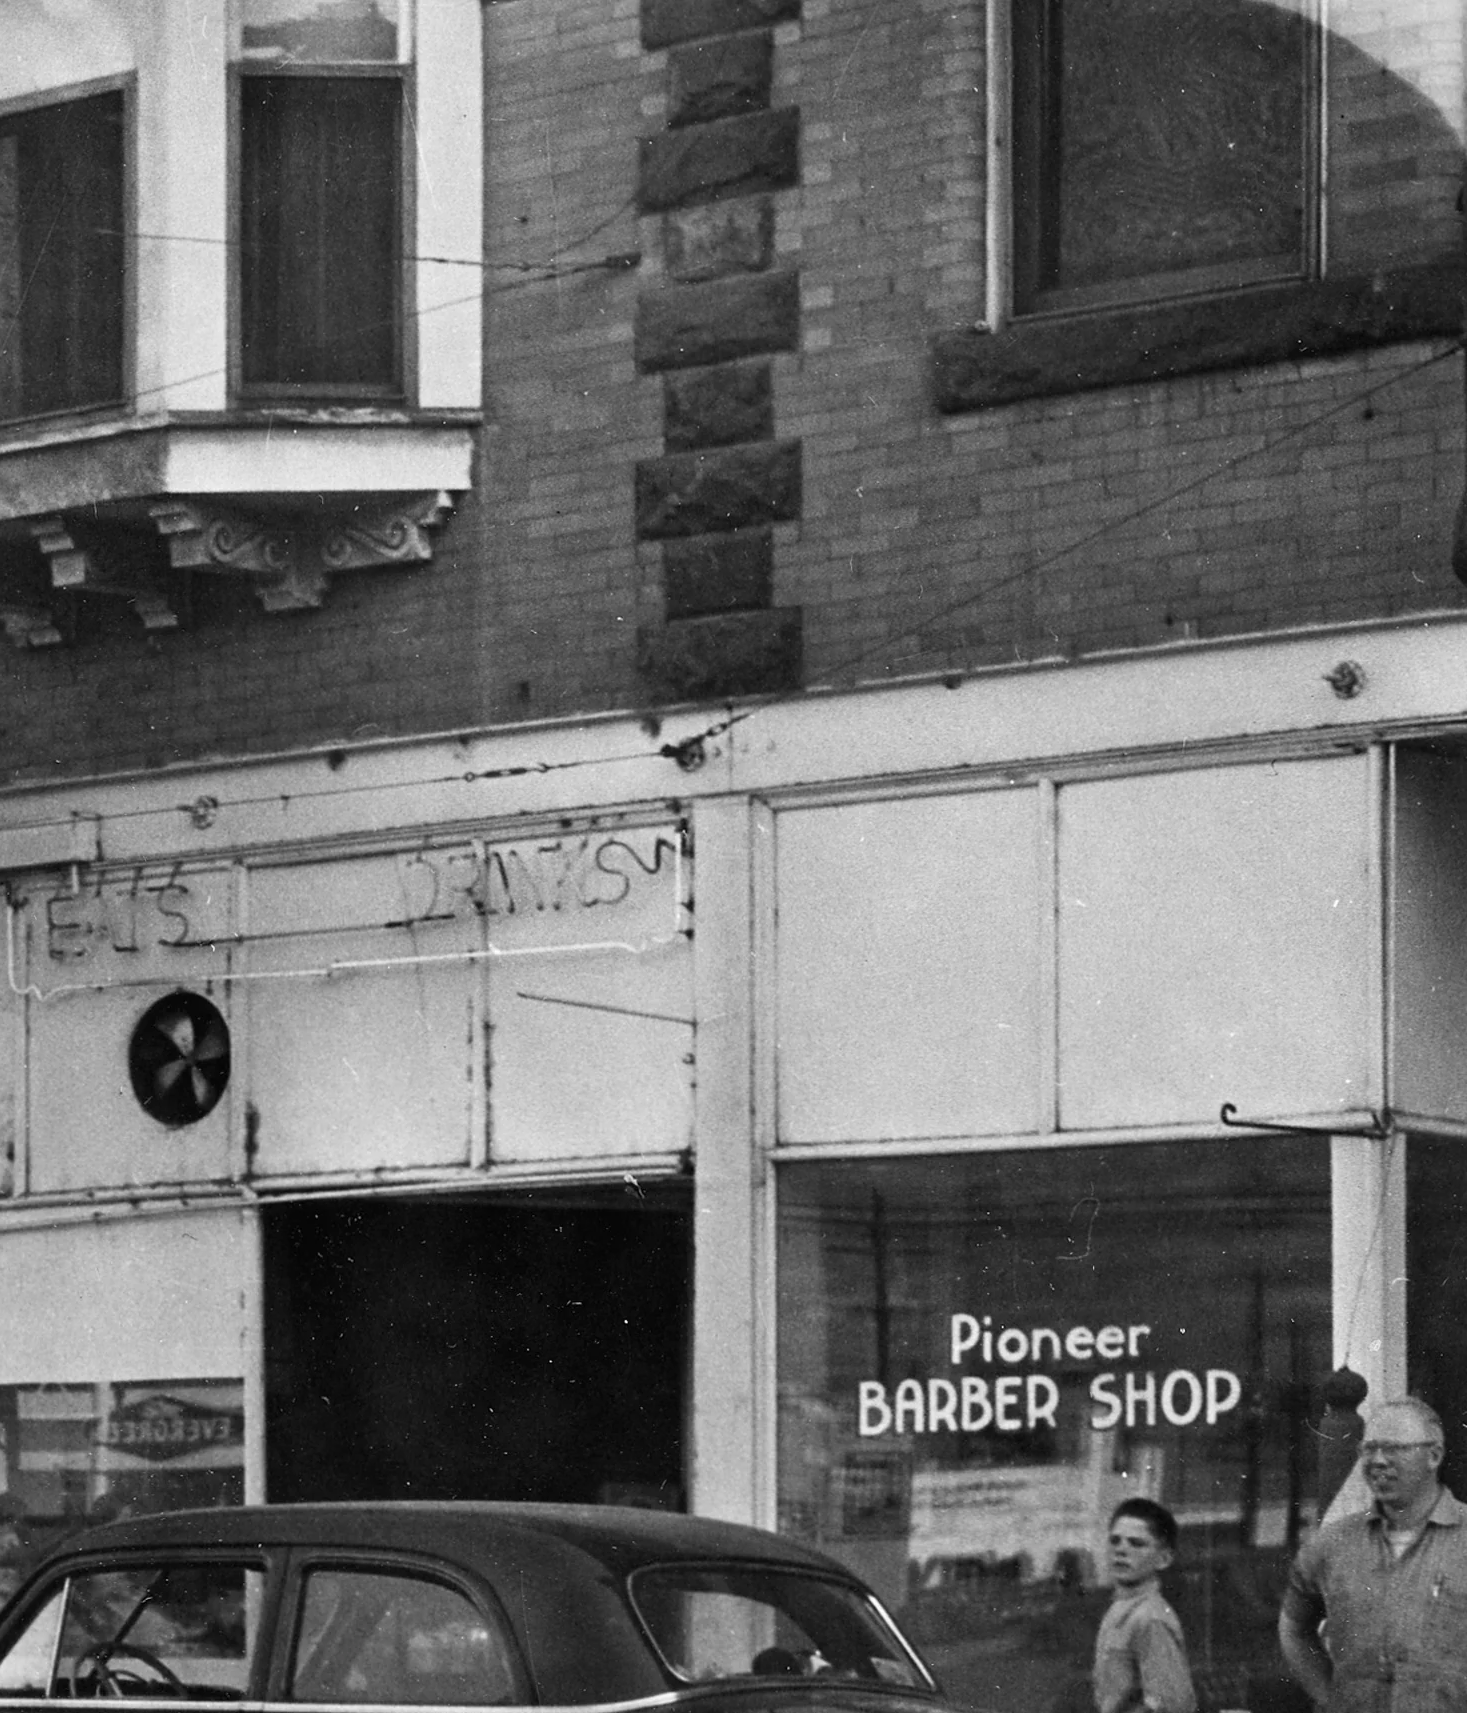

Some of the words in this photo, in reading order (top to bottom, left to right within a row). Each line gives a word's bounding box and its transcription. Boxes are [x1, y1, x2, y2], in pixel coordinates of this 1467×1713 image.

[951, 1313, 1151, 1364] Pioneer
[859, 1374, 1060, 1437] BARBER
[1090, 1369, 1241, 1430] SHOP
